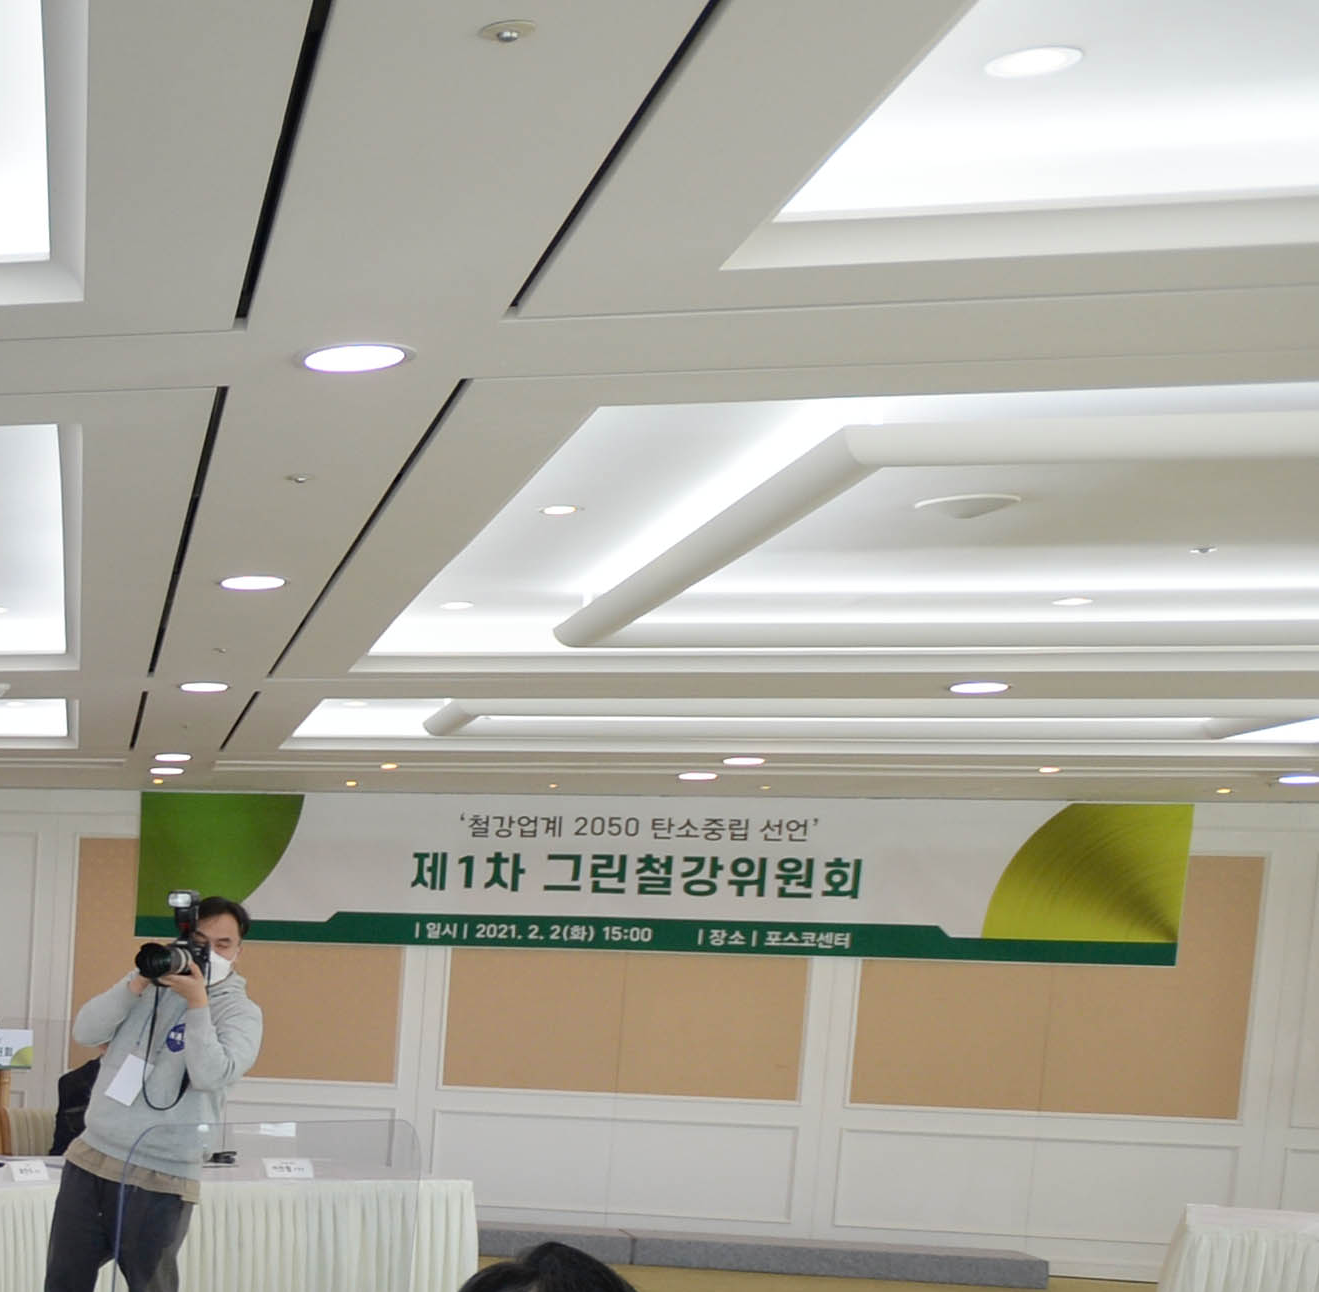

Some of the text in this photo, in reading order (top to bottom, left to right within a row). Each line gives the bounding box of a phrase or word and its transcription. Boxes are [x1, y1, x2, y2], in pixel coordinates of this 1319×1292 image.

[574, 816, 640, 836] 2050
[651, 817, 749, 841] 탄소중립
[411, 851, 863, 899] 제1차 그린철강위원회
[426, 922, 653, 942] 일시 2021. 2. 2(화) 15:00
[708, 929, 851, 949] 장소 포스코센터
